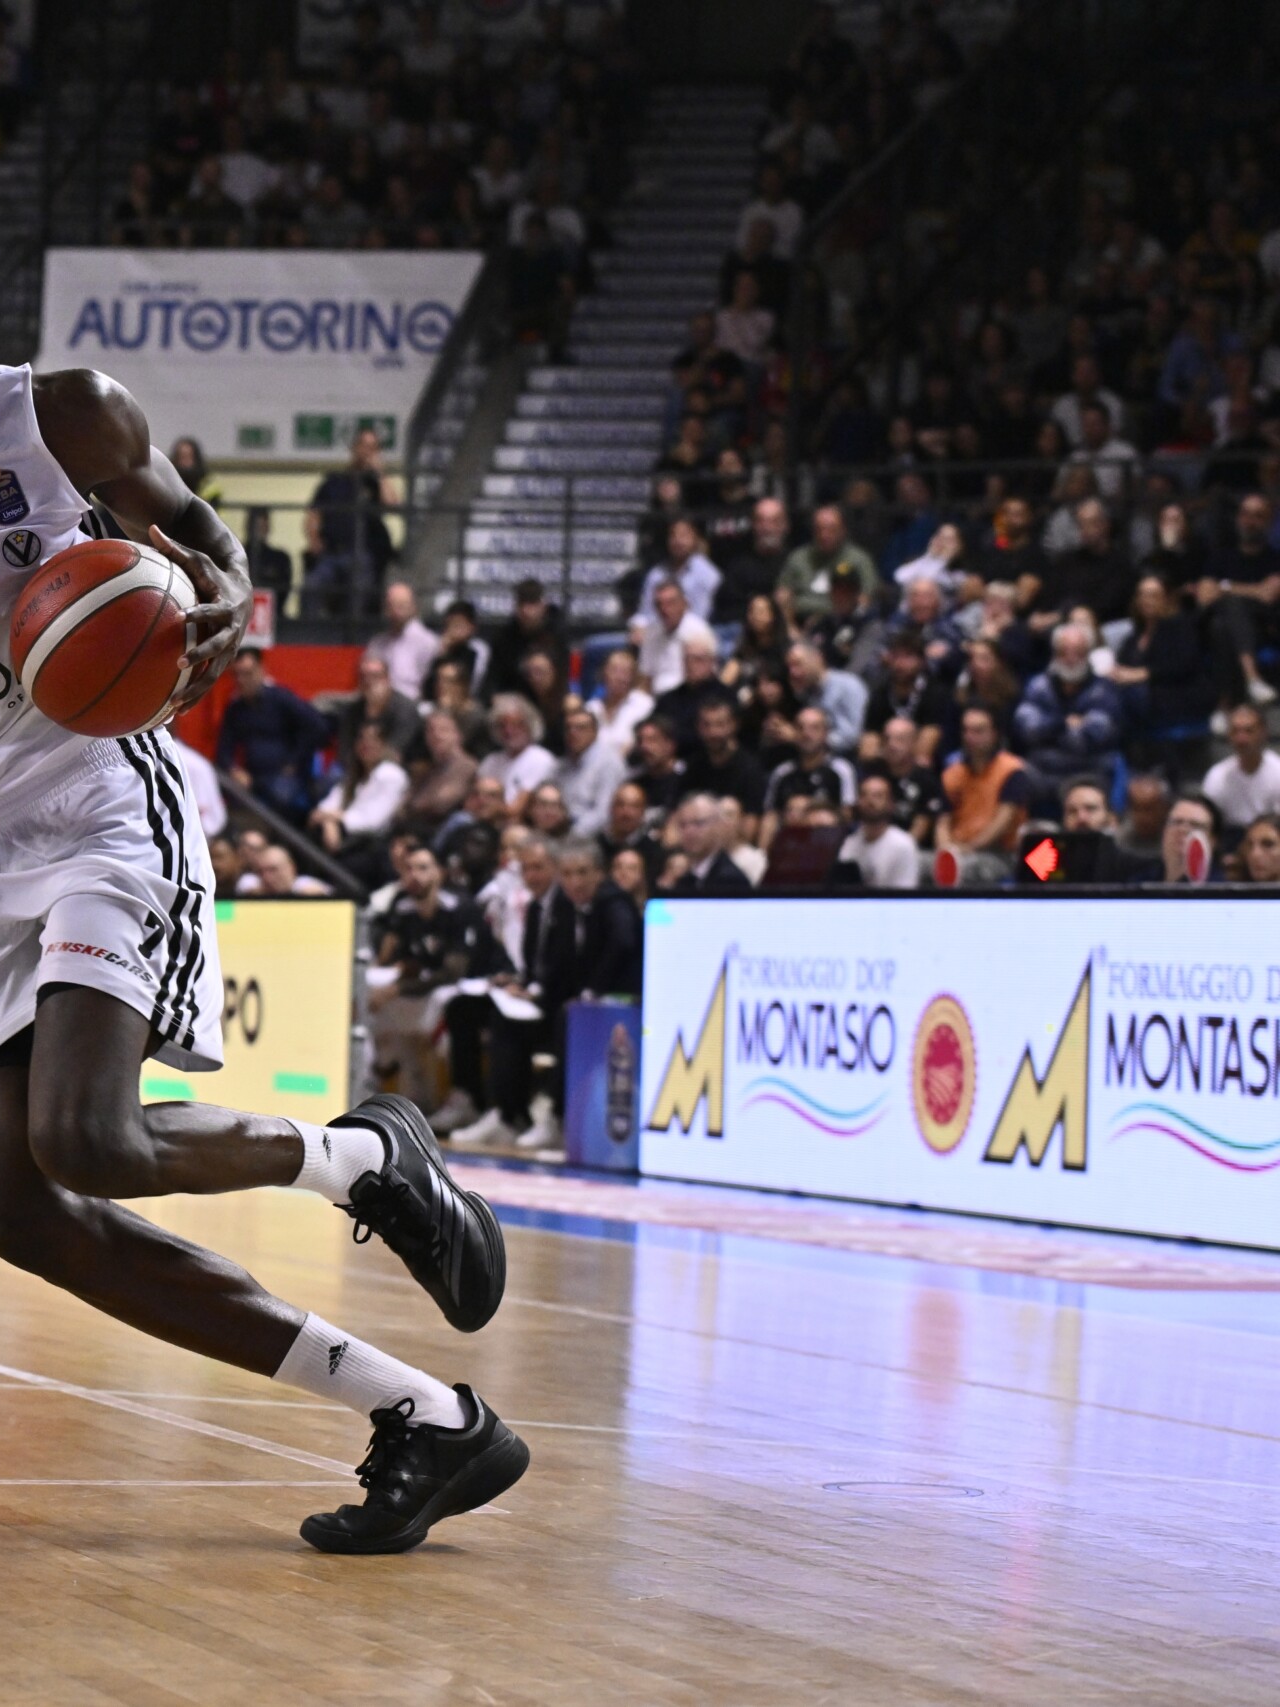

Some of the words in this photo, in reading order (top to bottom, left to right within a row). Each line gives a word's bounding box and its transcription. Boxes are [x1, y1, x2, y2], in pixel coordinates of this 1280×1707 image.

[68, 298, 458, 353] AUTOTORINO
[2, 504, 25, 519] Unipol
[7, 692, 25, 709] OF
[138, 910, 166, 960] 7
[737, 957, 847, 989] FORMAGGIO
[1107, 961, 1254, 1003] FORMAGGIO
[736, 1000, 897, 1073] MONTASIO
[1104, 1011, 1280, 1098] MONTASI
